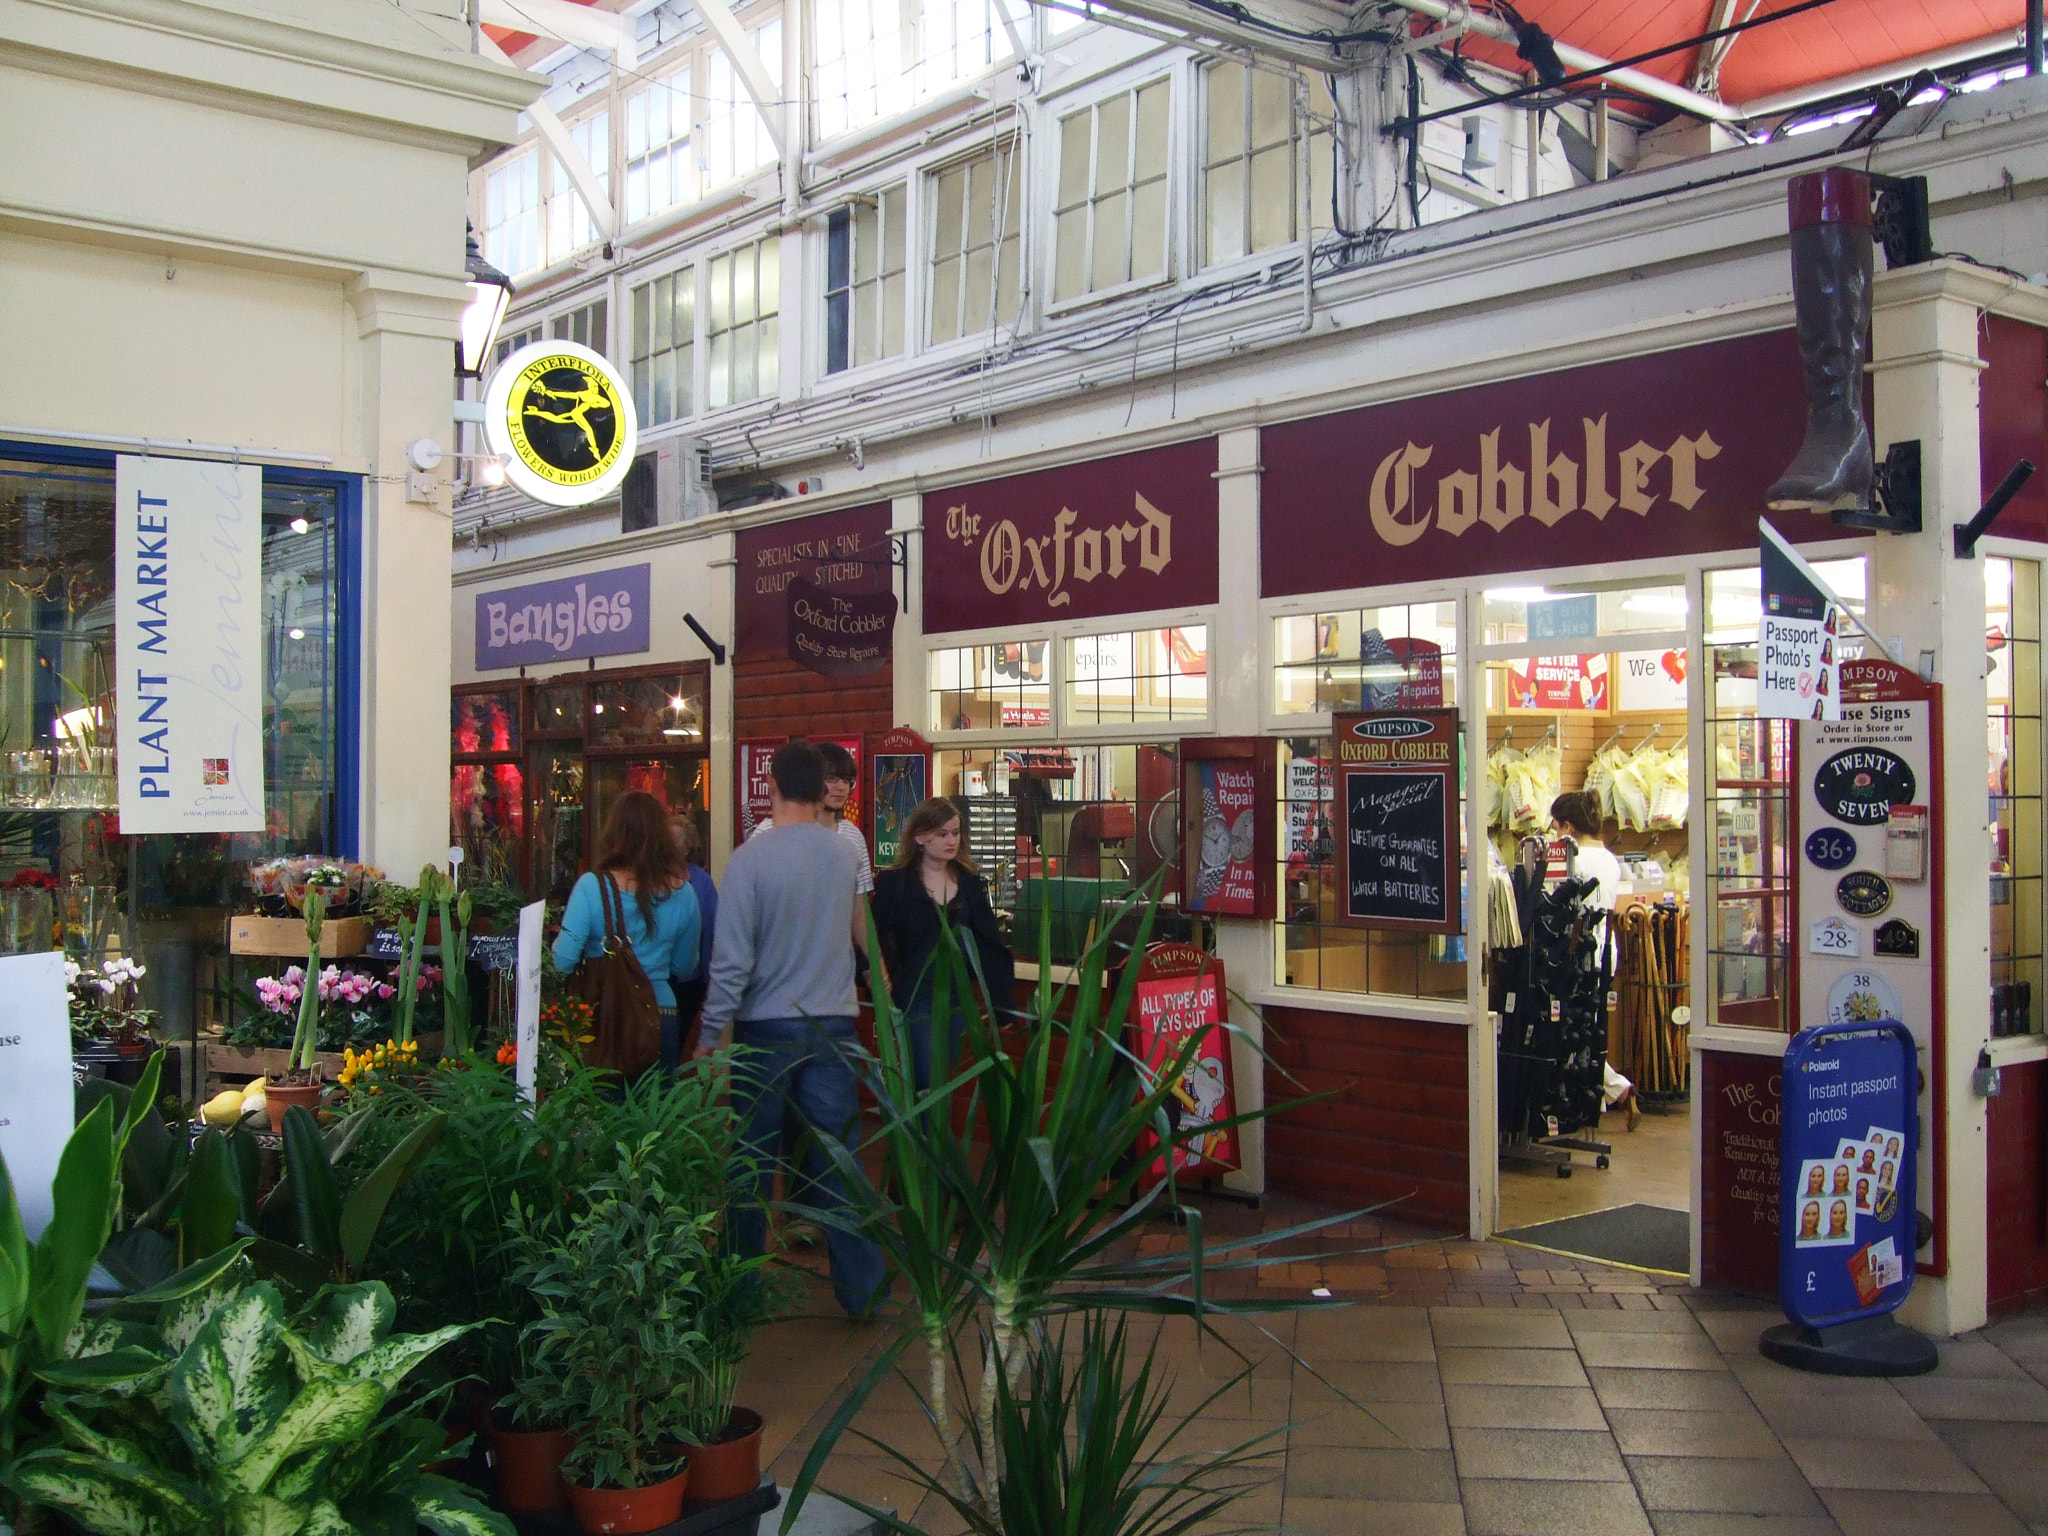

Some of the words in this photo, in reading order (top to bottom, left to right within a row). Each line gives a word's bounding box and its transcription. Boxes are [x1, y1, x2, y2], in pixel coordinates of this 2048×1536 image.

[523, 357, 612, 391] INTERFLORA
[511, 422, 555, 478] FLOWERS
[560, 468, 602, 483] WORLD
[602, 437, 623, 470] WIDE
[1369, 412, 1722, 547] Cobbler
[757, 541, 812, 567] SPECIALISTS
[818, 539, 829, 557] IN
[946, 504, 981, 549] The
[980, 491, 1172, 606] Oxford
[137, 490, 168, 654] MARKET
[815, 563, 863, 585] SITCHED
[832, 598, 853, 613] The
[486, 582, 633, 651] Bangles
[794, 599, 837, 632] Oxford
[840, 613, 886, 633] Cobbler
[1766, 621, 1818, 648] Passport
[795, 633, 824, 656] Quality
[827, 645, 848, 658] Shoe
[850, 646, 879, 661] Repairs
[1766, 645, 1811, 668] Photo's
[1075, 650, 1118, 671] epairs
[1538, 653, 1579, 666] BETTER
[1627, 659, 1656, 677] We
[1765, 670, 1796, 690] Here
[1842, 666, 1898, 683] MPSON
[1402, 683, 1440, 699] Repairs
[1841, 710, 1864, 721] use
[1870, 705, 1911, 721] Signs
[137, 669, 170, 798] PLANT
[1365, 722, 1420, 735] TIMPSON
[1824, 725, 1849, 734] Order
[1854, 724, 1862, 732] in
[1866, 724, 1890, 732] Store
[884, 735, 913, 747] TIMPSON
[1829, 734, 1912, 744] www.timpson.com
[1341, 740, 1388, 761] OXFORD
[1392, 739, 1449, 761] COBBLER
[1830, 753, 1896, 776] TWENTY
[1216, 771, 1254, 788] Watch
[1292, 777, 1332, 786] WELCOME
[750, 798, 771, 807] GUARAN
[1353, 778, 1428, 813] Managers
[1379, 778, 1438, 825] Special
[1292, 803, 1314, 813] New
[1838, 800, 1889, 818] SEVEN
[1292, 816, 1335, 827] Students
[1292, 839, 1335, 852] DISCOUN
[1351, 827, 1387, 850] LIFETIME
[1388, 832, 1439, 858] GUARANTEE
[1817, 837, 1843, 860] 36
[1230, 866, 1241, 880] In
[1380, 855, 1396, 868] ON
[1400, 856, 1418, 872] ALL
[1846, 876, 1880, 888] SOUTH
[1384, 880, 1440, 905] BATTERIES
[1840, 895, 1886, 913] COTTAGE
[1823, 930, 1847, 948] 28
[1883, 929, 1908, 949] 49
[1150, 950, 1203, 970] TIMPSON
[1854, 975, 1870, 987] 38
[1141, 995, 1161, 1015] ALL
[1162, 991, 1198, 1012] TYPES
[1200, 989, 1214, 1007] OF
[1153, 1014, 1182, 1034] KEYS
[1184, 1010, 1206, 1030] CUT
[1808, 1059, 1839, 1072] Polaroid
[1722, 1083, 1756, 1107] The
[1808, 1081, 1848, 1100] Instant
[1851, 1075, 1897, 1098] passport
[1808, 1107, 1848, 1128] photos
[1723, 1131, 1774, 1150] Traditional
[1737, 1168, 1755, 1181] NOT
[1759, 1170, 1765, 1182] A
[1731, 1185, 1764, 1207] Quality
[1806, 1271, 1816, 1292] £
